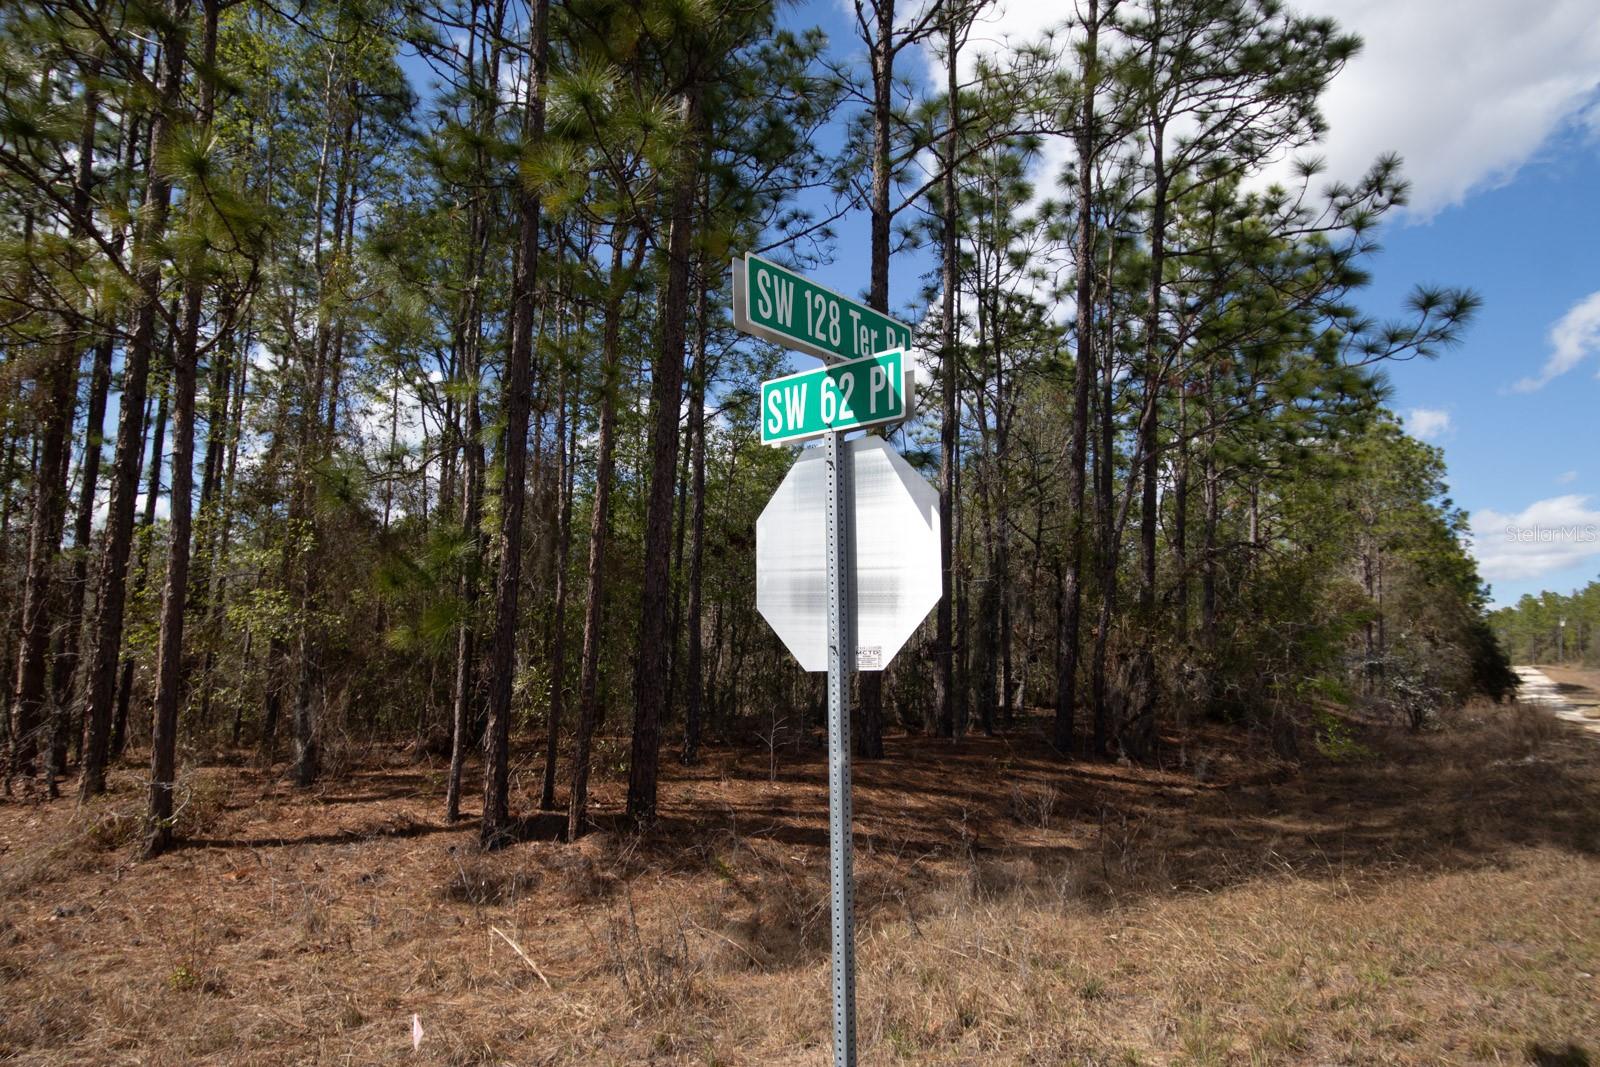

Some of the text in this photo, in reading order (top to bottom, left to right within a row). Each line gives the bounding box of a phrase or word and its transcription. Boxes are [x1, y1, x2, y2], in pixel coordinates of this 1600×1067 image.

[757, 268, 794, 328] SW
[804, 289, 841, 347] 128
[848, 308, 878, 357] Ter
[767, 382, 808, 435] SW
[820, 371, 855, 424] 62
